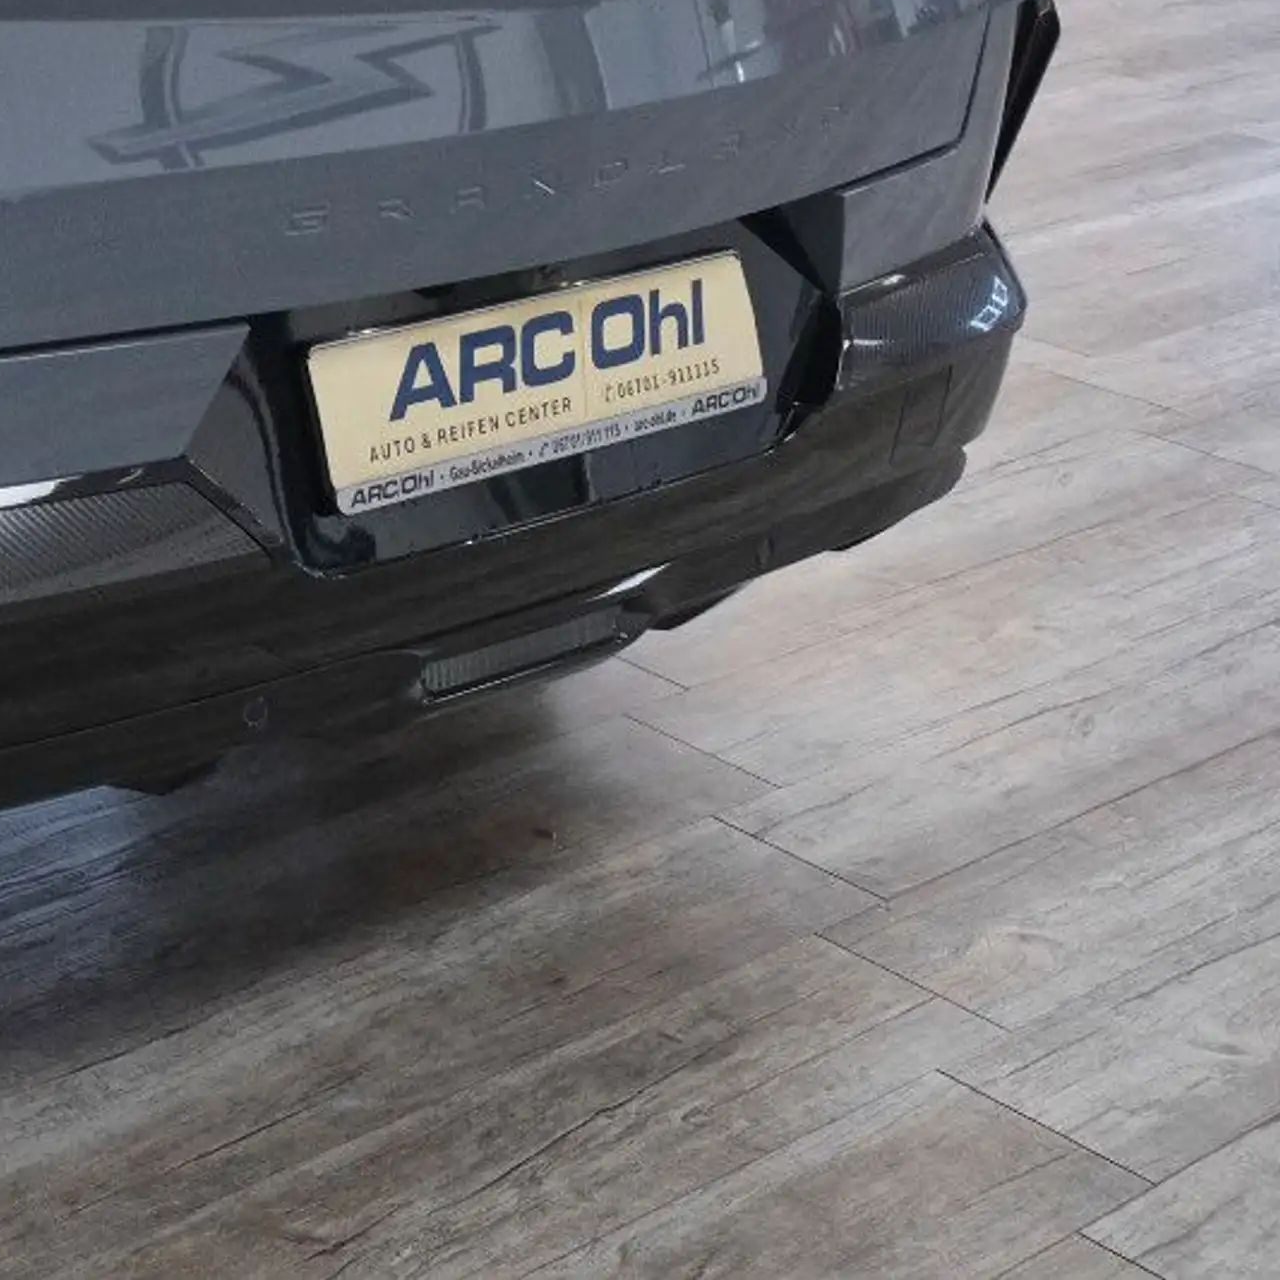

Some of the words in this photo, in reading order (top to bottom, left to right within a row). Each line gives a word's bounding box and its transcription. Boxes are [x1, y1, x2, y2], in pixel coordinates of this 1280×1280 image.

[389, 310, 576, 422] ARC
[590, 278, 705, 370] Ohl
[369, 437, 416, 464] AUTO
[420, 432, 433, 450] &
[437, 414, 500, 446] REIFEN
[504, 397, 573, 428] CENTER
